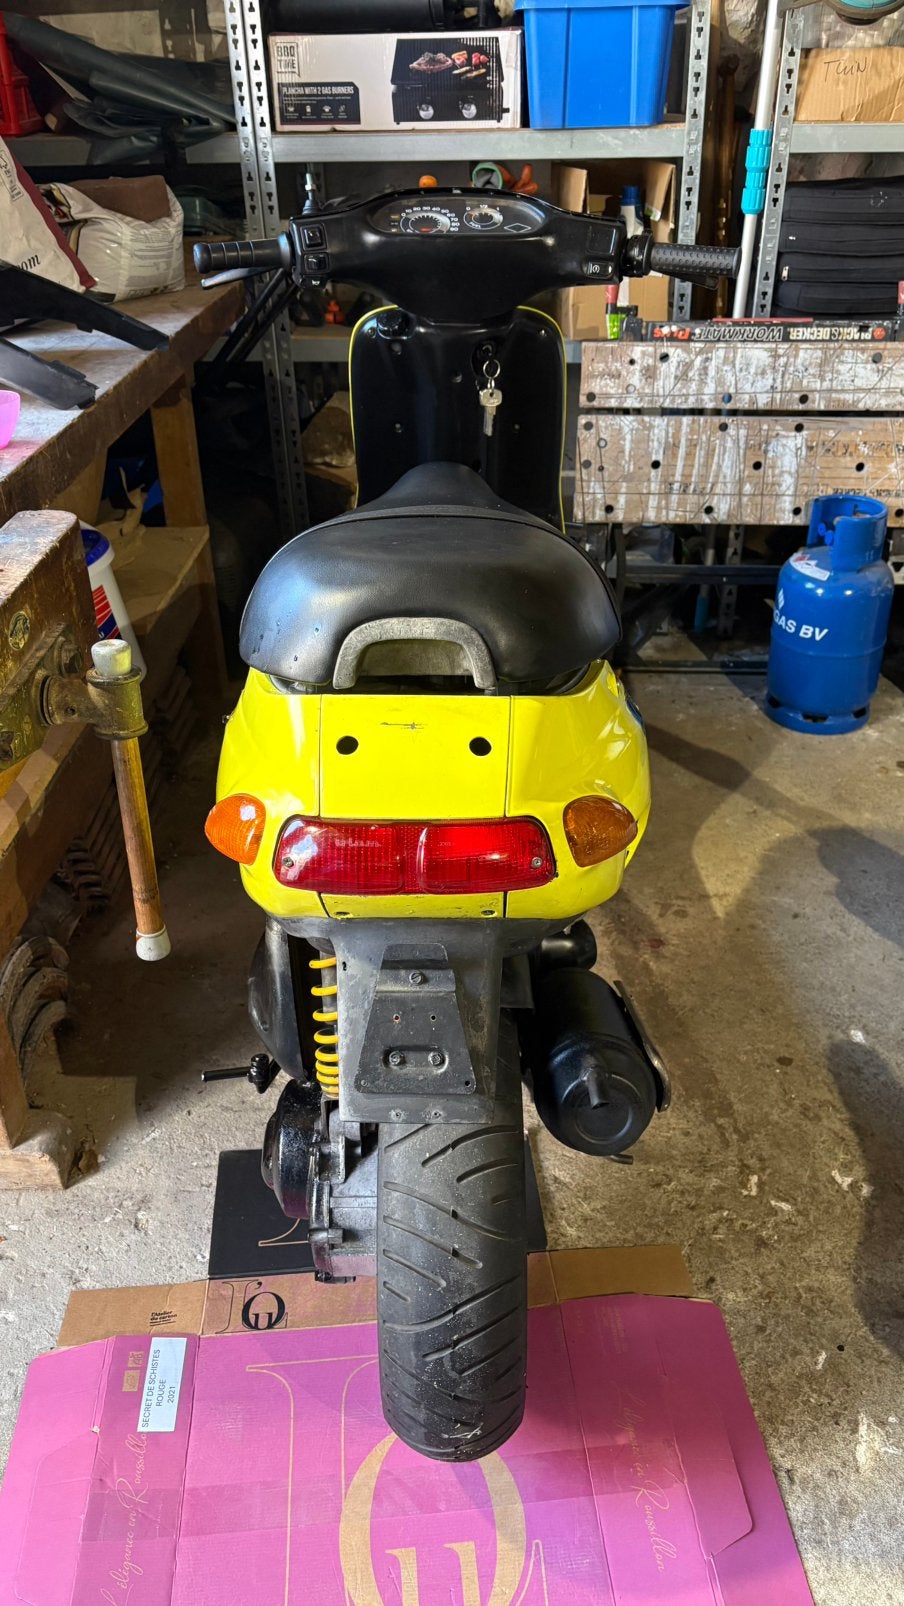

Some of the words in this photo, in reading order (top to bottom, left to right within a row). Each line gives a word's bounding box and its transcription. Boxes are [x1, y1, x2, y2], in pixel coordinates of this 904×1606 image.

[276, 58, 297, 69] TIME
[283, 86, 304, 95] PLANCHA
[304, 86, 317, 95] WITH
[321, 86, 332, 95] GAS
[332, 86, 354, 95] BURNERS
[695, 326, 784, 341] WORKMATE
[798, 624, 829, 641] BV
[148, 1349, 161, 1385] SCHISTES
[146, 1385, 155, 1397] DE
[155, 1379, 167, 1407] ROUGE
[167, 1386, 176, 1404] 2021
[141, 1398, 153, 1428] SECRET
[115, 1434, 149, 1509] Roussillo
